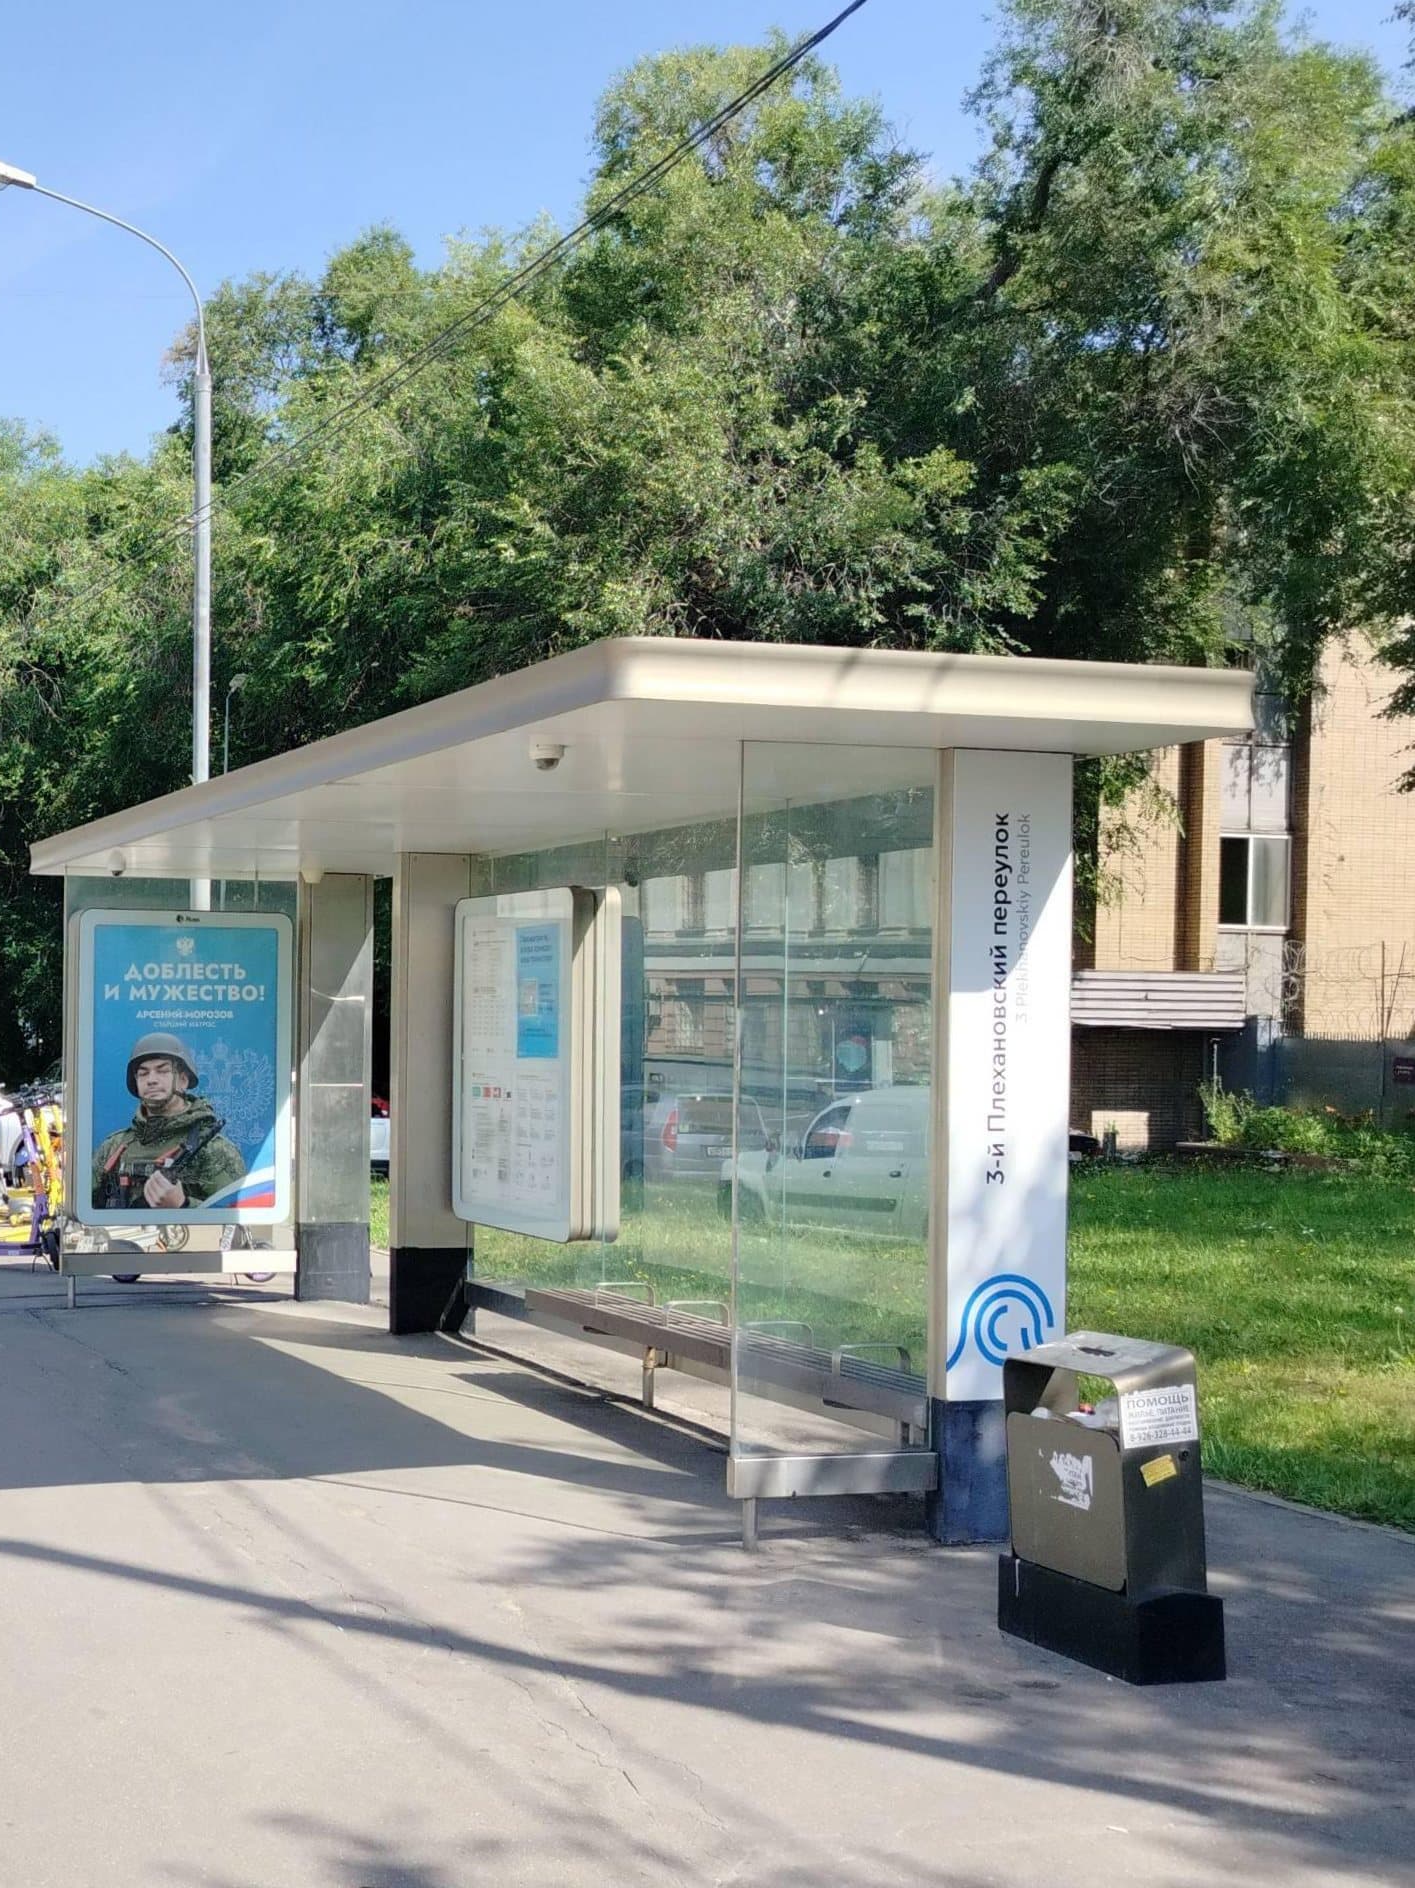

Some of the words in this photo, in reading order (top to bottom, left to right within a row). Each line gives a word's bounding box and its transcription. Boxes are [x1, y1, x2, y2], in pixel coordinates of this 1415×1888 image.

[1016, 813, 1032, 884] Pereulok
[993, 813, 1013, 935] переулок
[124, 963, 246, 981] ДОБЛЕСТЬ
[104, 984, 120, 1001] И
[129, 984, 266, 1002] МУЖЕСТВО!
[135, 1008, 183, 1020] АРСЕНИЙ
[184, 1009, 234, 1020] МОРОЗОВ
[987, 945, 1008, 1132] Плехановский
[986, 1143, 1005, 1185] 3-й
[1127, 1393, 1189, 1409] ПОМОЩЬ
